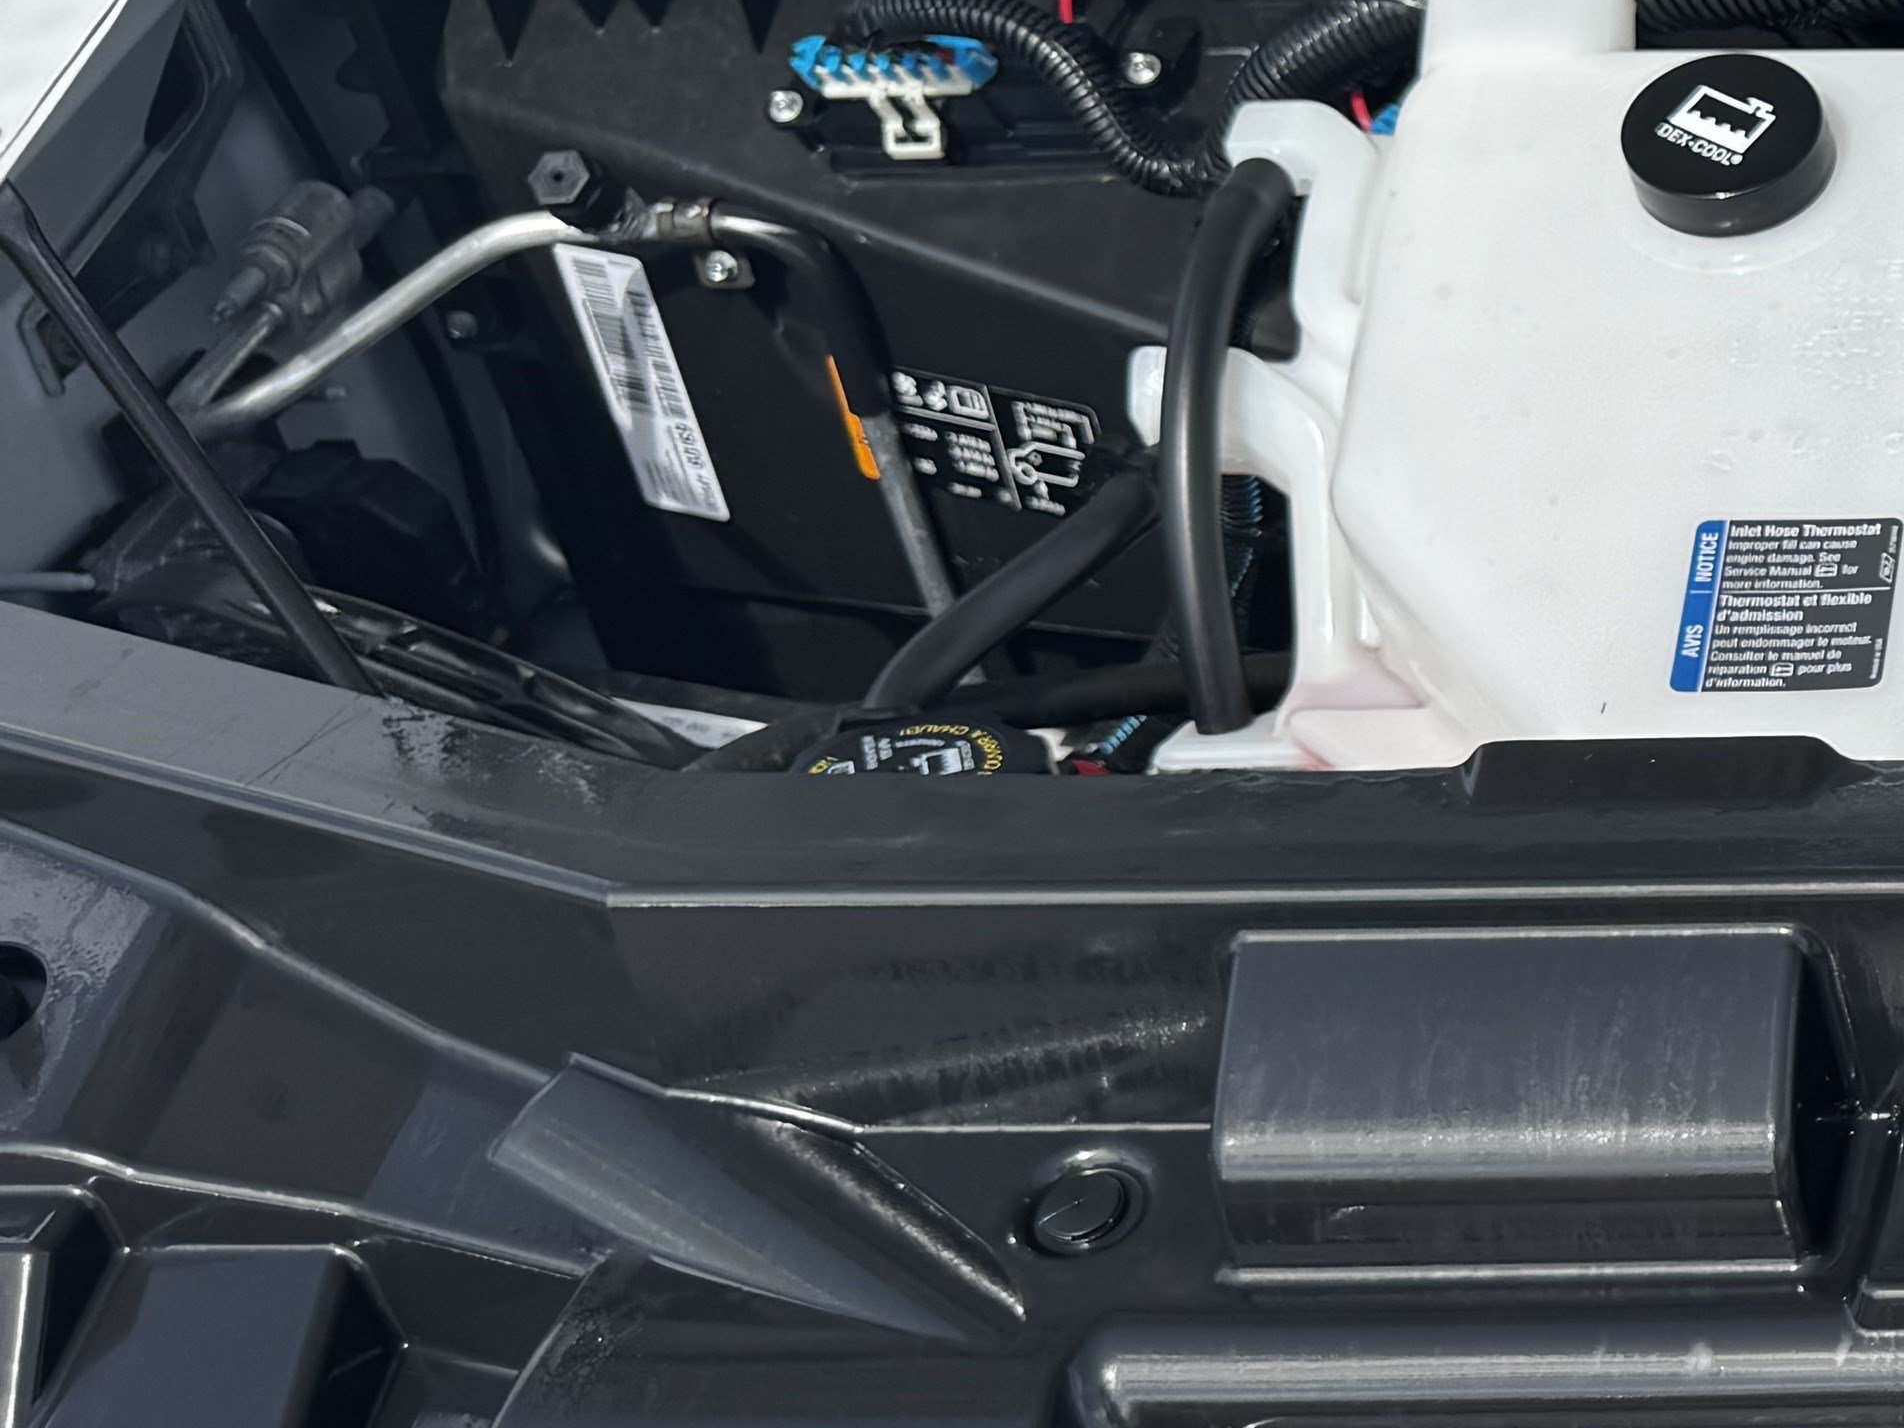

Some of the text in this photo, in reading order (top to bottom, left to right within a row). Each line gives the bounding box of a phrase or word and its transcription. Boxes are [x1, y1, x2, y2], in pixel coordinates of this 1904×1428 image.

[1730, 523, 1881, 537] Inlet Hose Thermostat
[1728, 540, 1857, 552] Improper fill can cause
[1694, 532, 1718, 583] NOTICE
[1726, 553, 1764, 565] engine
[1819, 552, 1841, 562] See
[1724, 565, 1858, 576] Service Manual for
[1722, 579, 1823, 589] more information.
[1720, 593, 1872, 607] Thermostat et flexible
[1717, 609, 1804, 622] d'admission
[1715, 622, 1857, 635] Un remplissage incorrect
[1682, 624, 1704, 658] AVIS
[1712, 638, 1737, 649] peut
[1741, 637, 1814, 648] endommager
[1818, 636, 1828, 646] le
[1710, 649, 1842, 661] Consulter le manuel de
[1798, 663, 1824, 674] pour
[1827, 662, 1852, 674] plus
[1705, 677, 1786, 688] d'information.
